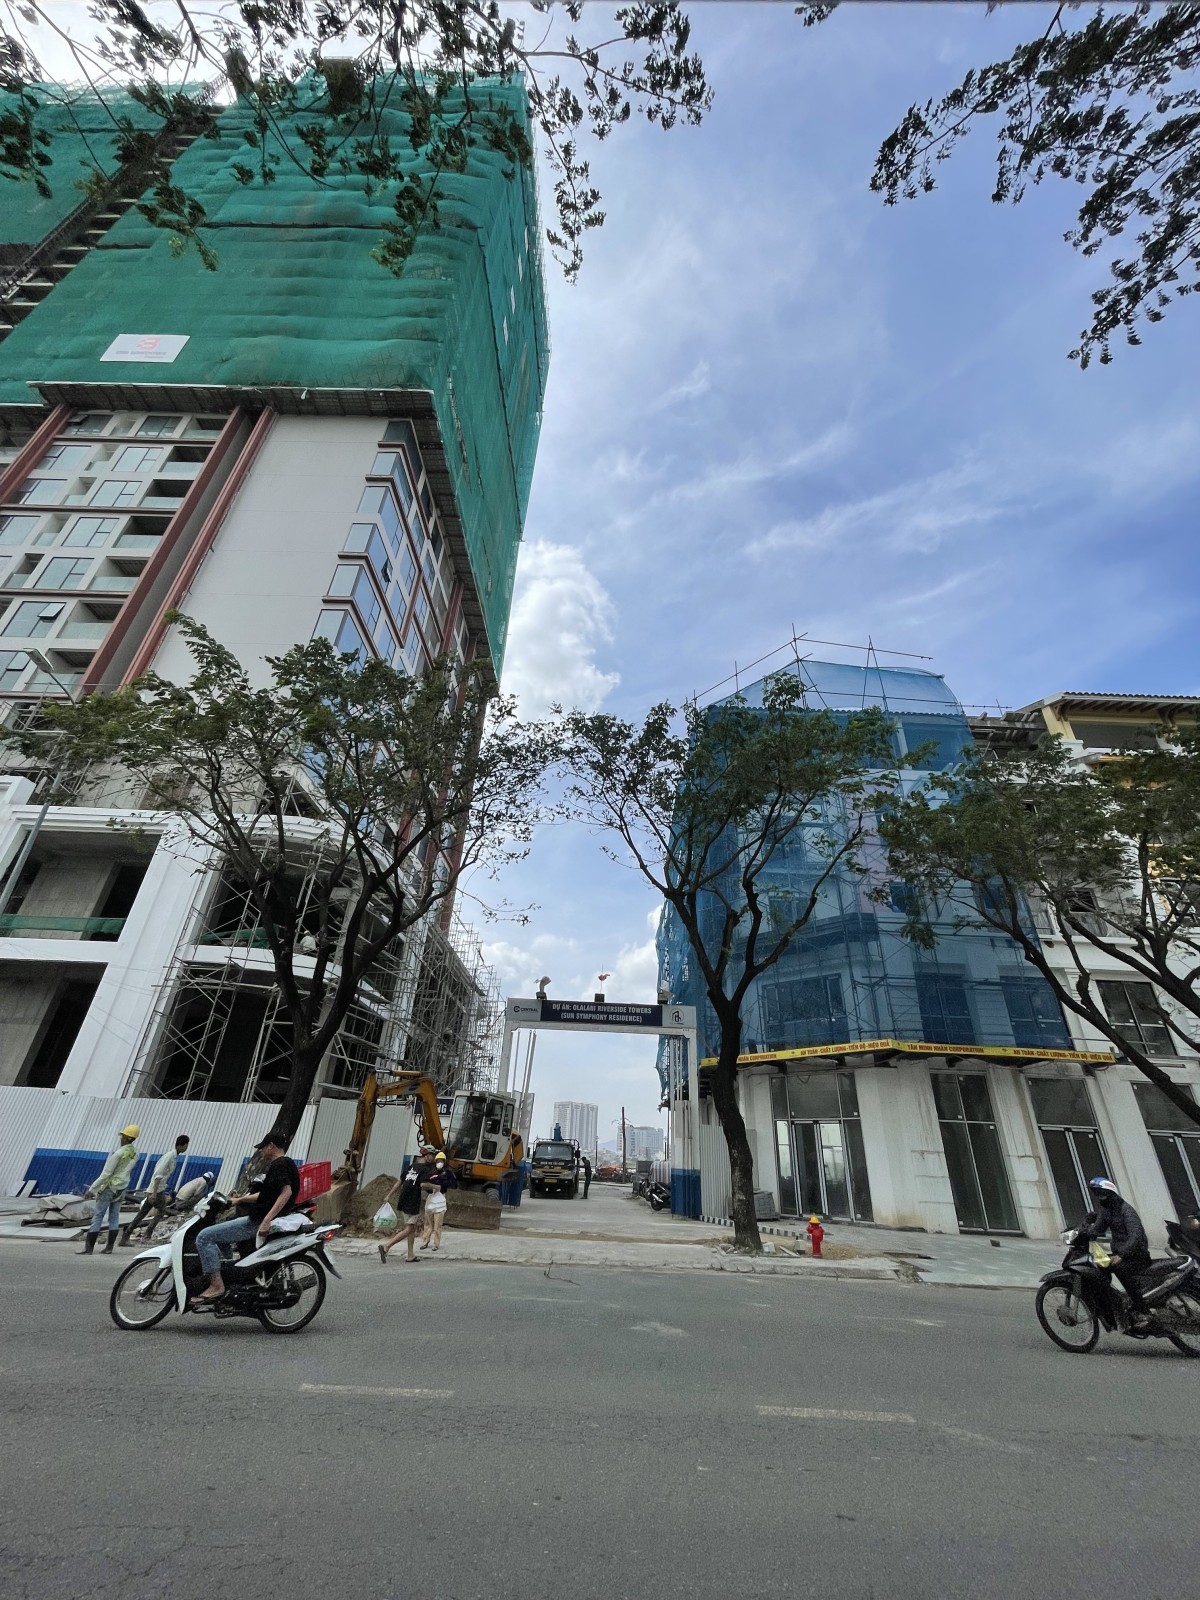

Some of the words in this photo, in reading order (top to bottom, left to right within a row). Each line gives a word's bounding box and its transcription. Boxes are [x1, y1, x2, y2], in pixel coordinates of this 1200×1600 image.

[561, 1003, 572, 1011] ÁN:
[597, 1005, 627, 1013] RIVERSIDE
[628, 1006, 652, 1014] TOWERS
[575, 1013, 608, 1021] SYMPHONY
[608, 1014, 642, 1022] RESIDENCE)
